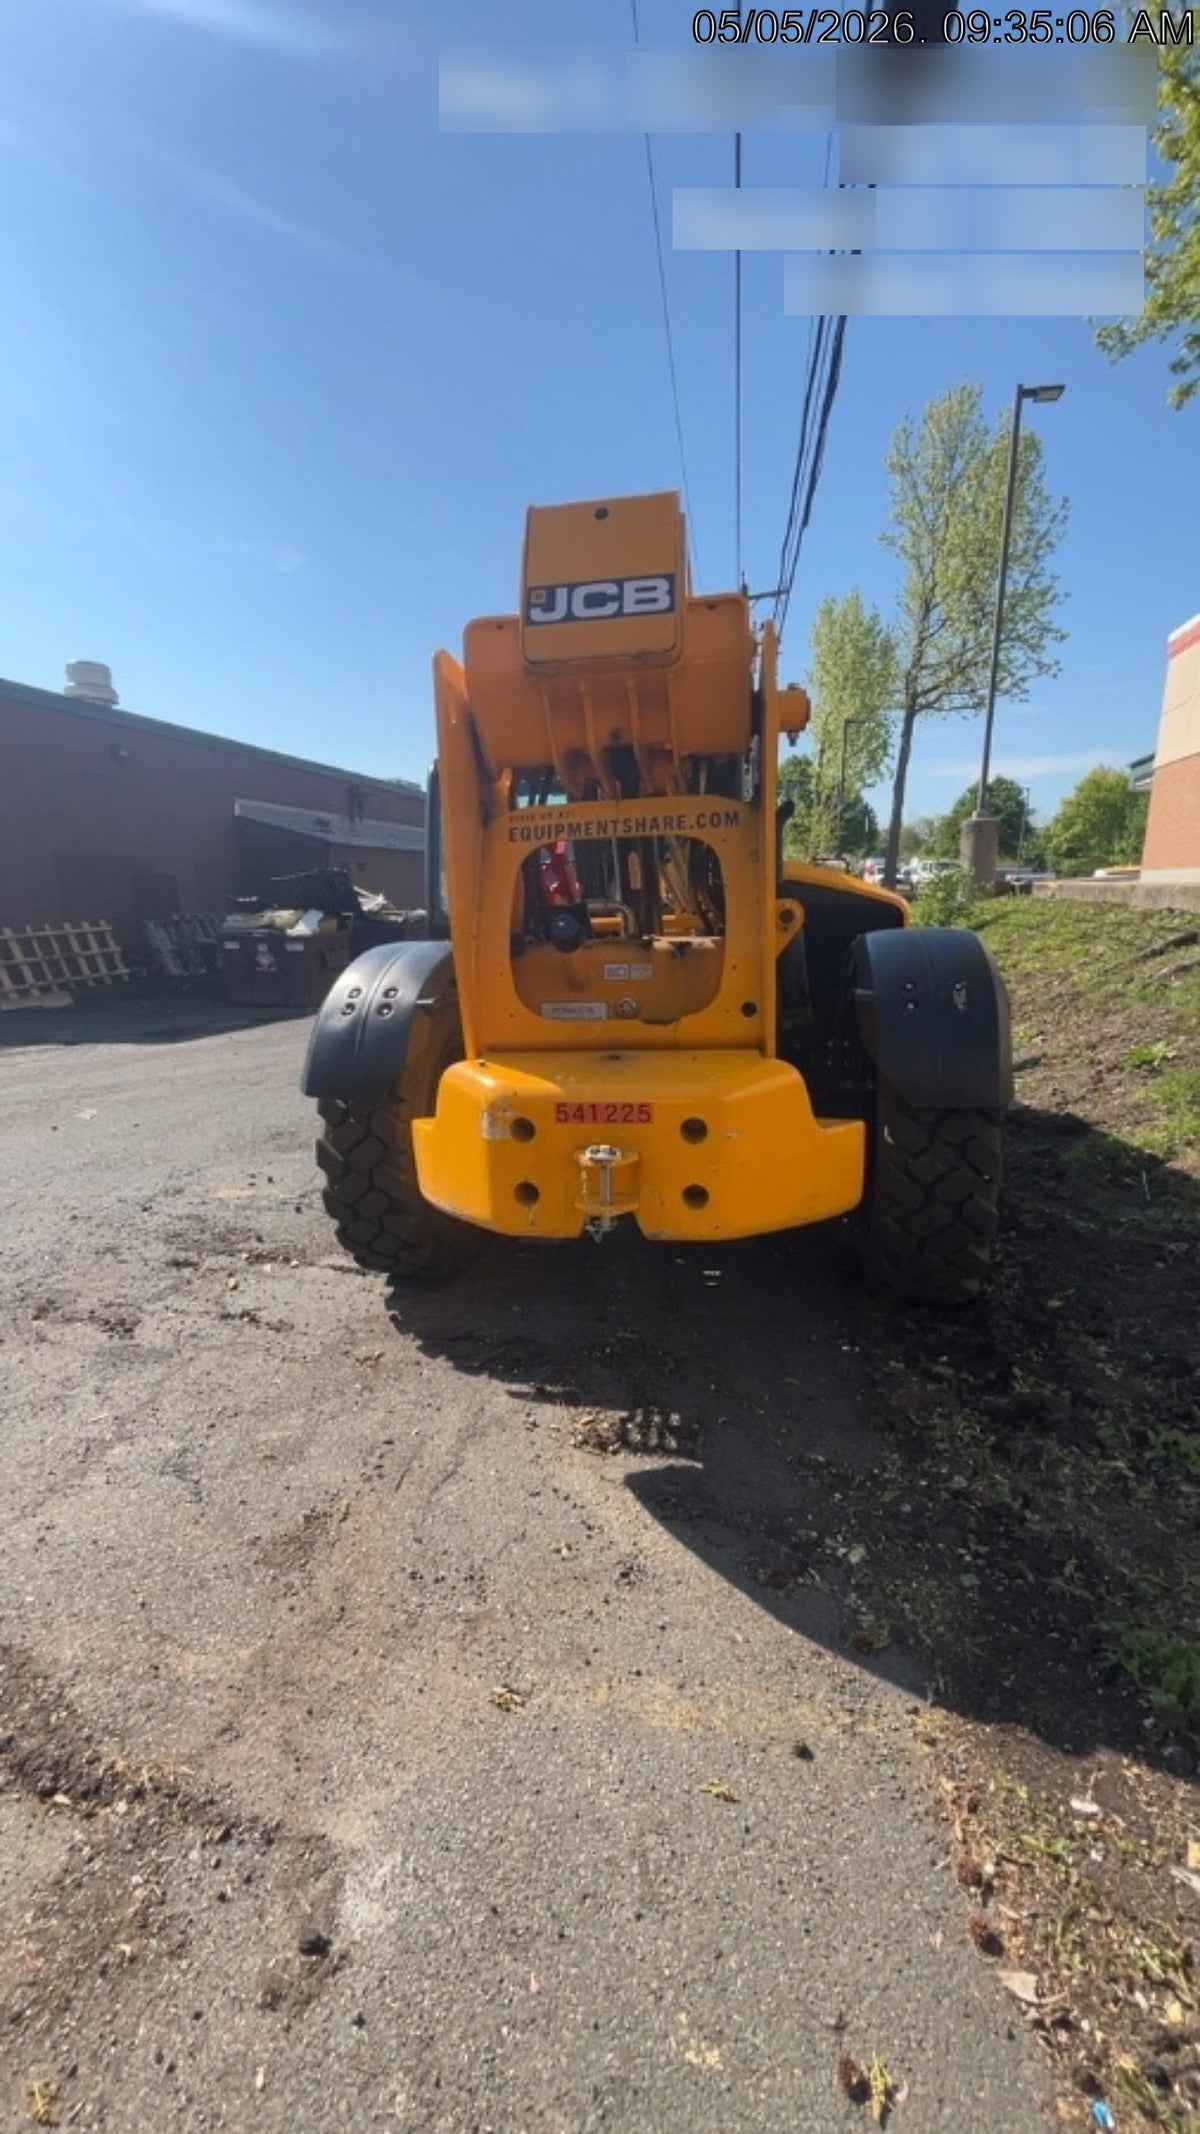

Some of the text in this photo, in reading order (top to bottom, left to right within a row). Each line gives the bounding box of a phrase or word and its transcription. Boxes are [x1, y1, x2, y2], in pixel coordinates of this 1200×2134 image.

[530, 578, 671, 622] JCB
[508, 811, 740, 842] EQUIPMENTSHARE.COM
[555, 1102, 652, 1124] 541225
